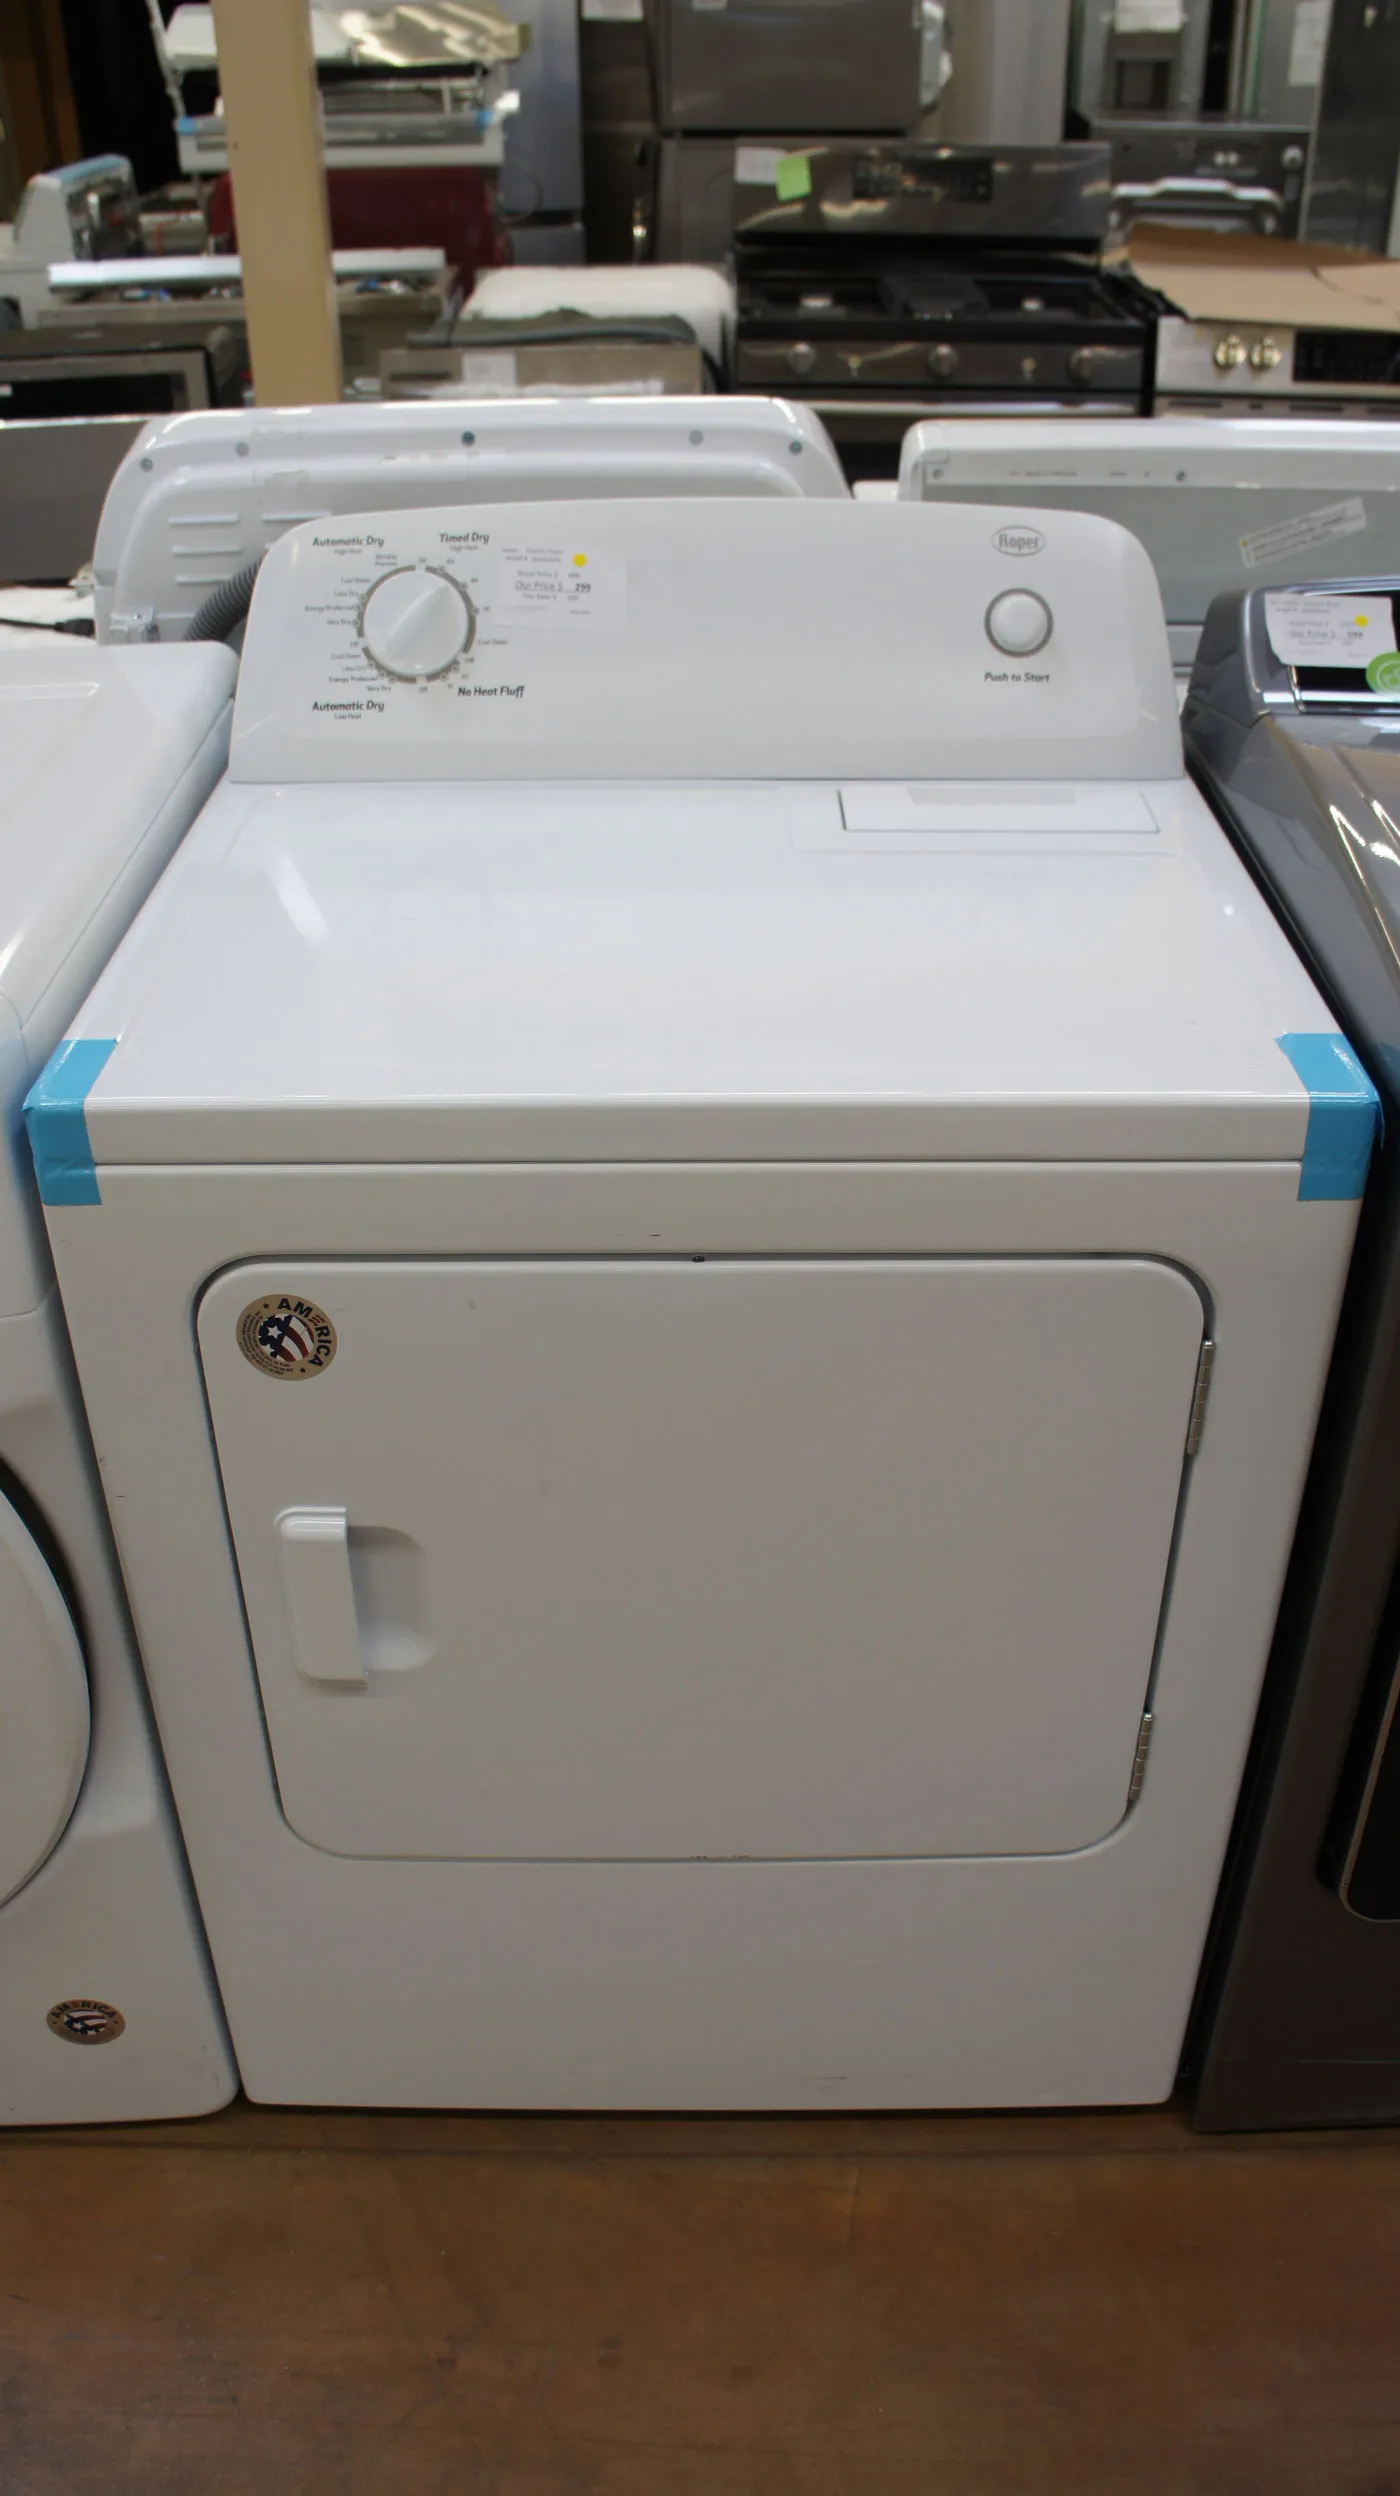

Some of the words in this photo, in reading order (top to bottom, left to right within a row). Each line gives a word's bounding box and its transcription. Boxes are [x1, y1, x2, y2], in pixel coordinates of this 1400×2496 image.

[312, 536, 364, 547] Automatic
[366, 535, 385, 548] Dry
[440, 531, 470, 543] Timed
[471, 530, 490, 545] Dry
[998, 533, 1040, 551] Roper
[515, 581, 532, 591] Our
[534, 581, 556, 591] Price
[575, 583, 592, 593] 299
[984, 672, 1009, 682] Push
[1011, 673, 1022, 682] to
[1024, 672, 1050, 682] Start
[457, 687, 472, 697] No
[474, 686, 498, 697] Heat
[500, 685, 525, 699] Fluff
[312, 701, 364, 712] Automatic
[366, 700, 385, 713] Dry
[277, 1298, 332, 1367] AMERICA
